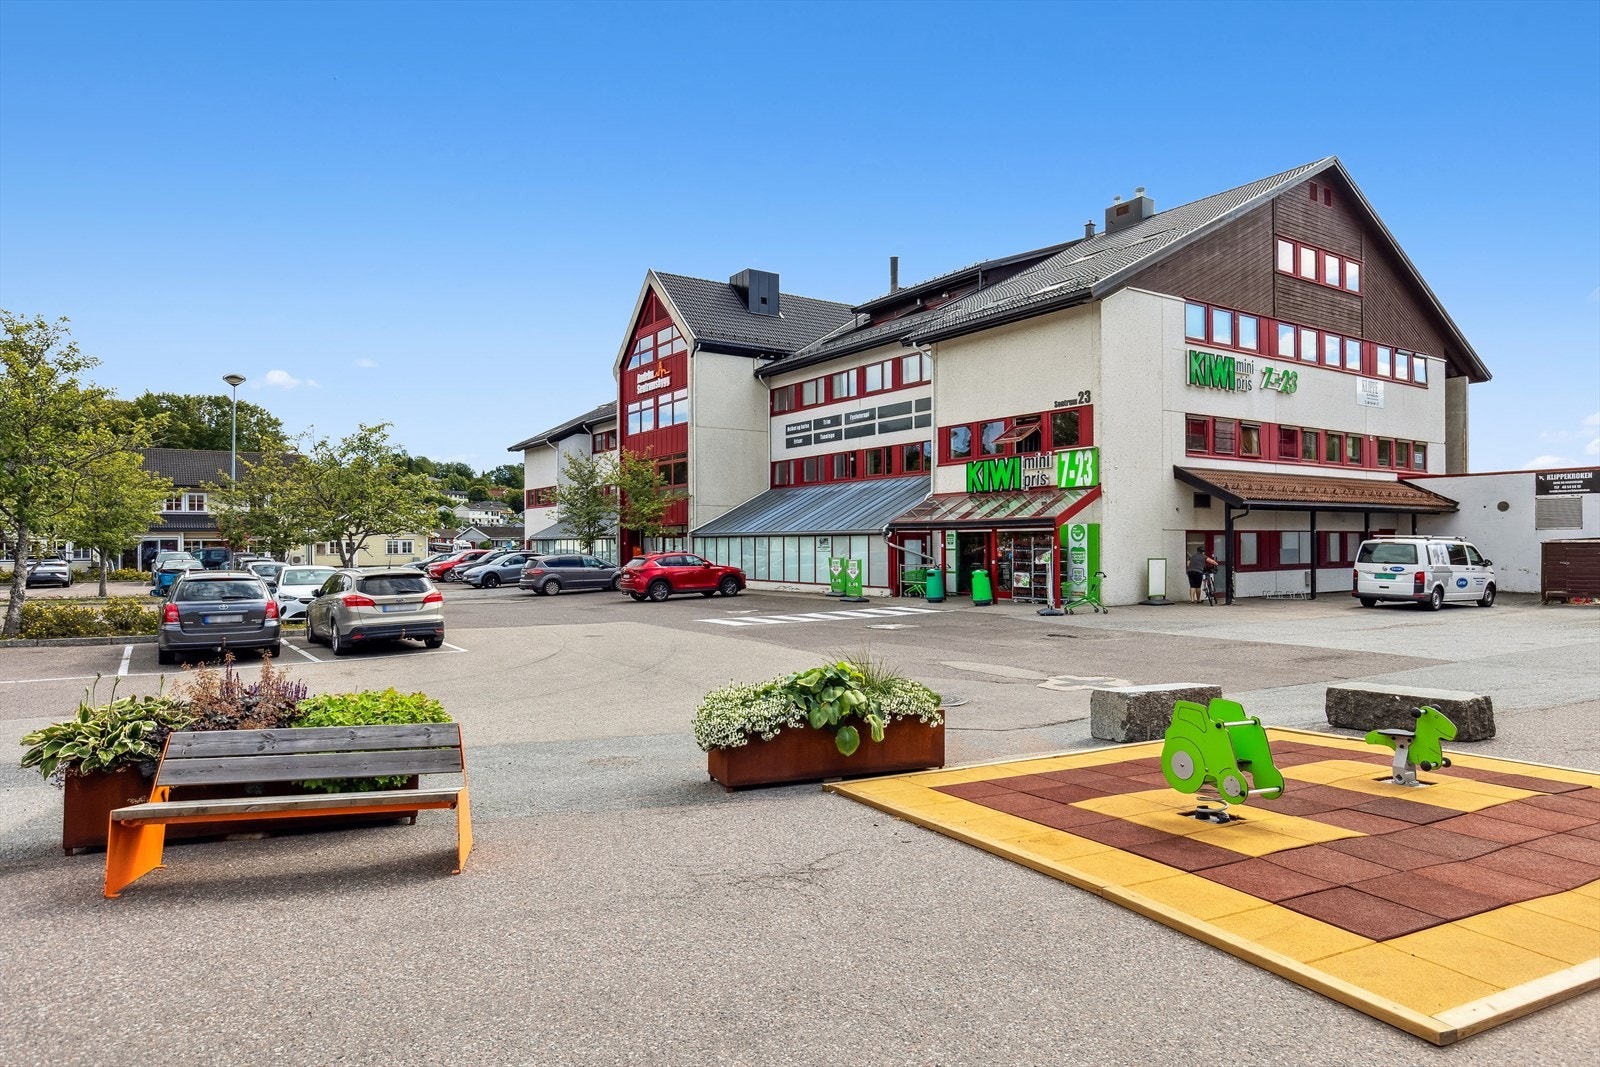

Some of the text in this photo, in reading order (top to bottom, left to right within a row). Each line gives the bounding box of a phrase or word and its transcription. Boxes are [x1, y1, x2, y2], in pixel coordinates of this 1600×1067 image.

[1188, 349, 1236, 391] KIWI
[1236, 359, 1254, 375] mini
[1236, 374, 1253, 392] pris
[1262, 366, 1298, 394] 7-23
[1054, 389, 1091, 408] Sentrum 23
[1024, 453, 1051, 469] mini
[1060, 450, 1093, 487] 7-23
[967, 457, 1021, 493] KIWI
[1024, 470, 1048, 488] pris
[1546, 472, 1593, 481] KLIPPEKROKEN
